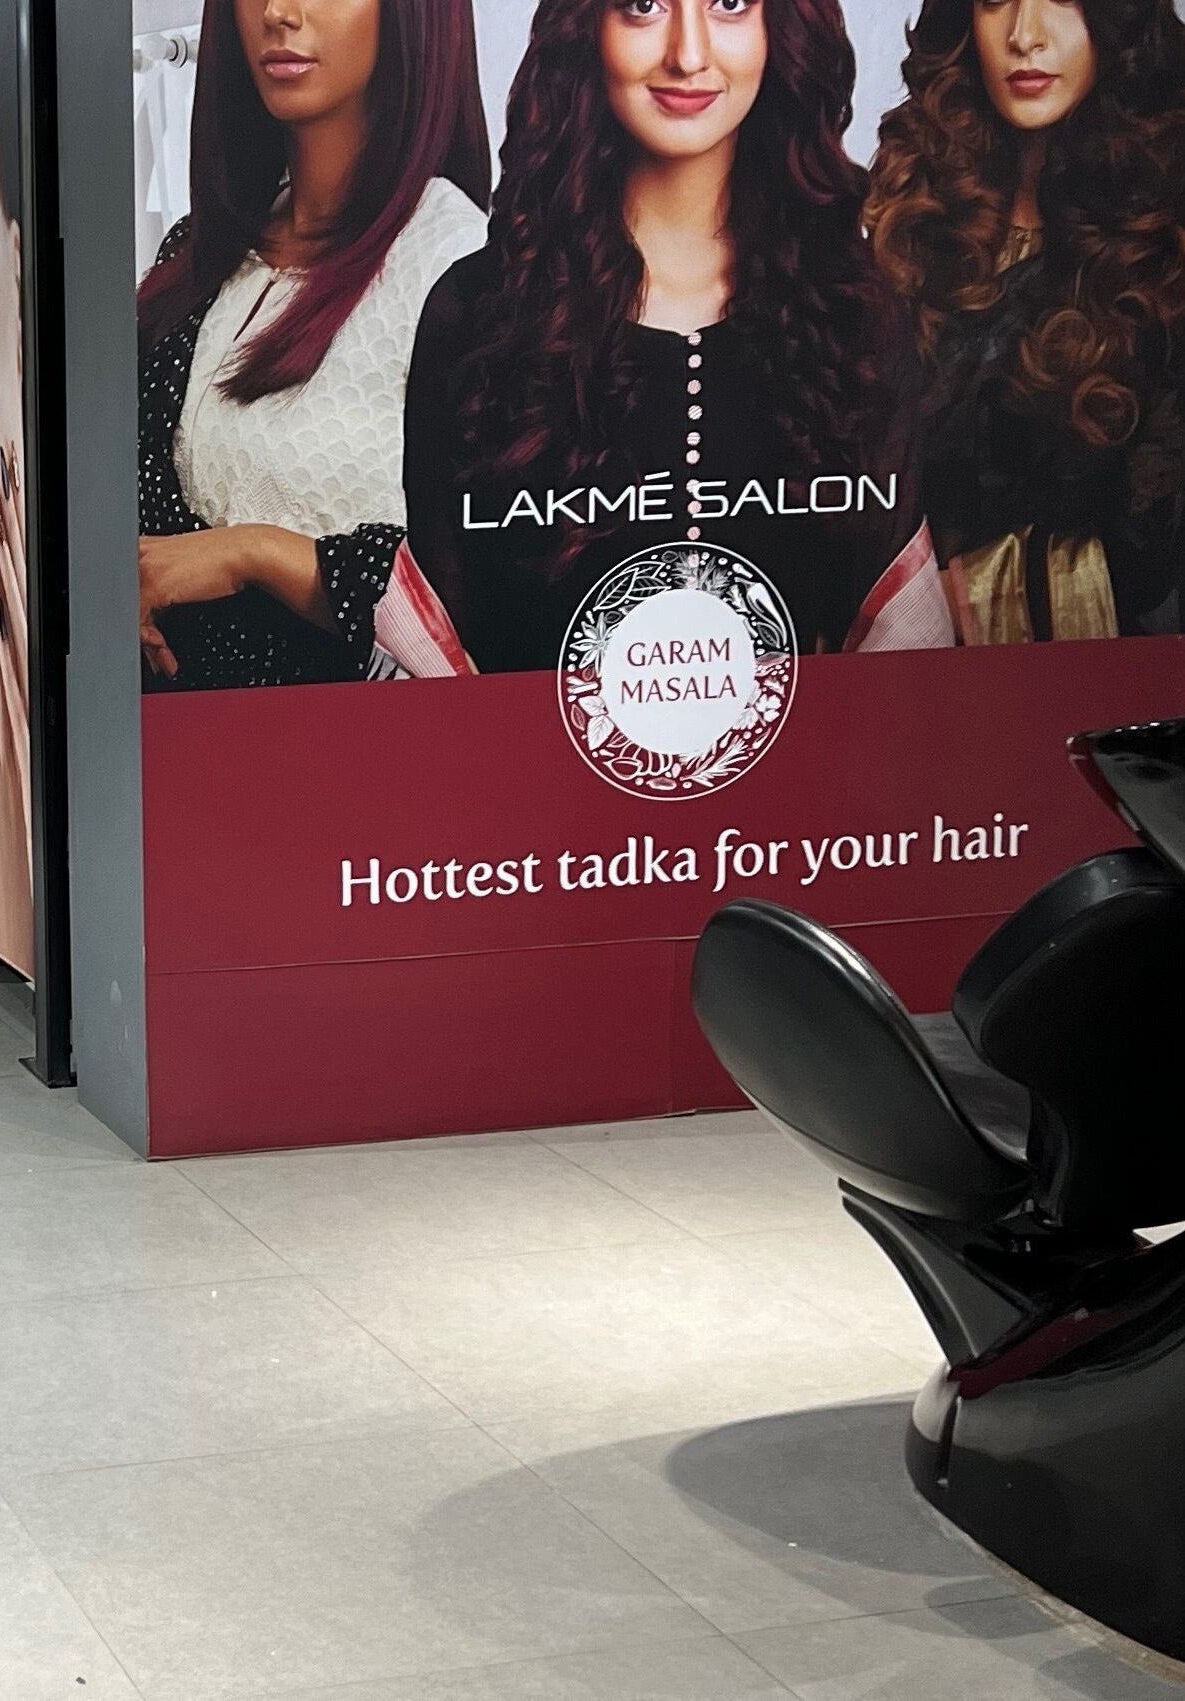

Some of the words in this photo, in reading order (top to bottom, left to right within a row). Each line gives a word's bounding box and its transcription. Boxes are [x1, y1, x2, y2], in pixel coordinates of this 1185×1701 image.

[463, 472, 675, 530] LAKMÉ
[691, 473, 898, 518] SALON
[626, 637, 732, 668] GARAM
[620, 675, 738, 706] MASALA
[340, 854, 544, 908] Hottest
[558, 836, 699, 891] tadka
[713, 829, 788, 893] for
[800, 831, 919, 887] your
[933, 814, 1030, 864] hair
